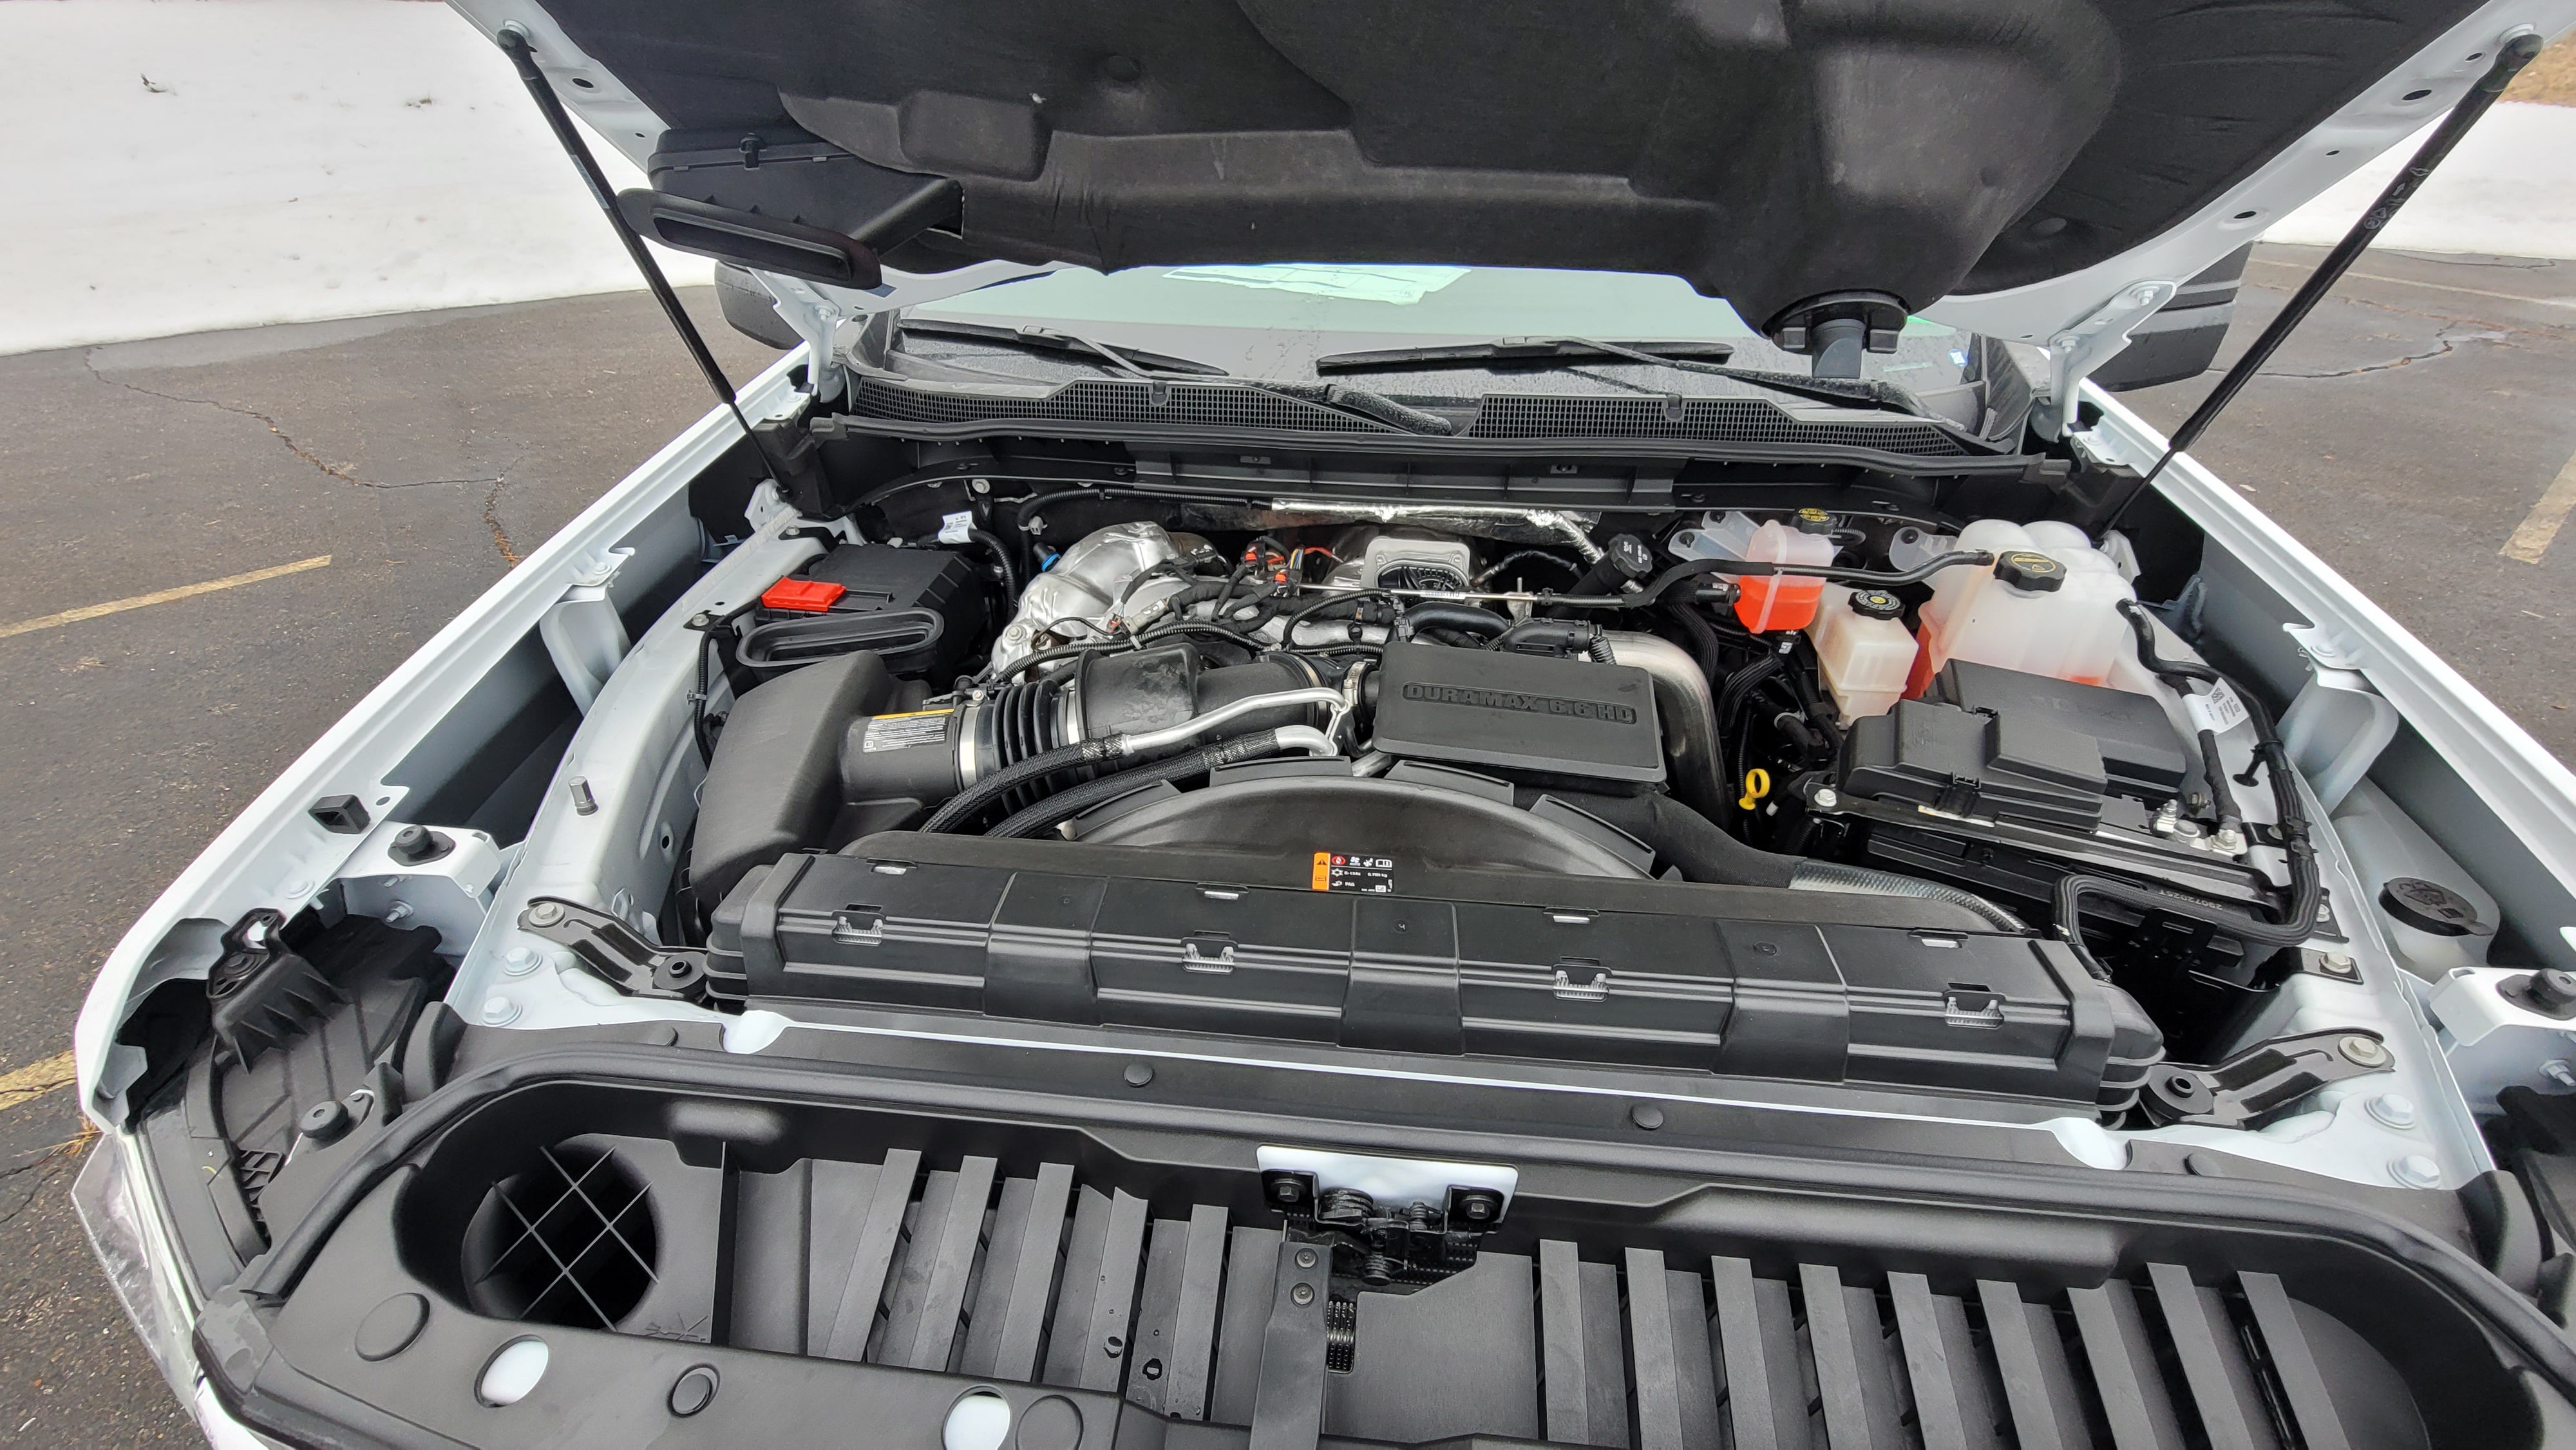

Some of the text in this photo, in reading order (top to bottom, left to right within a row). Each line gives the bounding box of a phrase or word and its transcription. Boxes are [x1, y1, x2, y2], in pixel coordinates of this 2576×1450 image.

[1407, 684, 1634, 723] DURAMAX 6.6 HD
